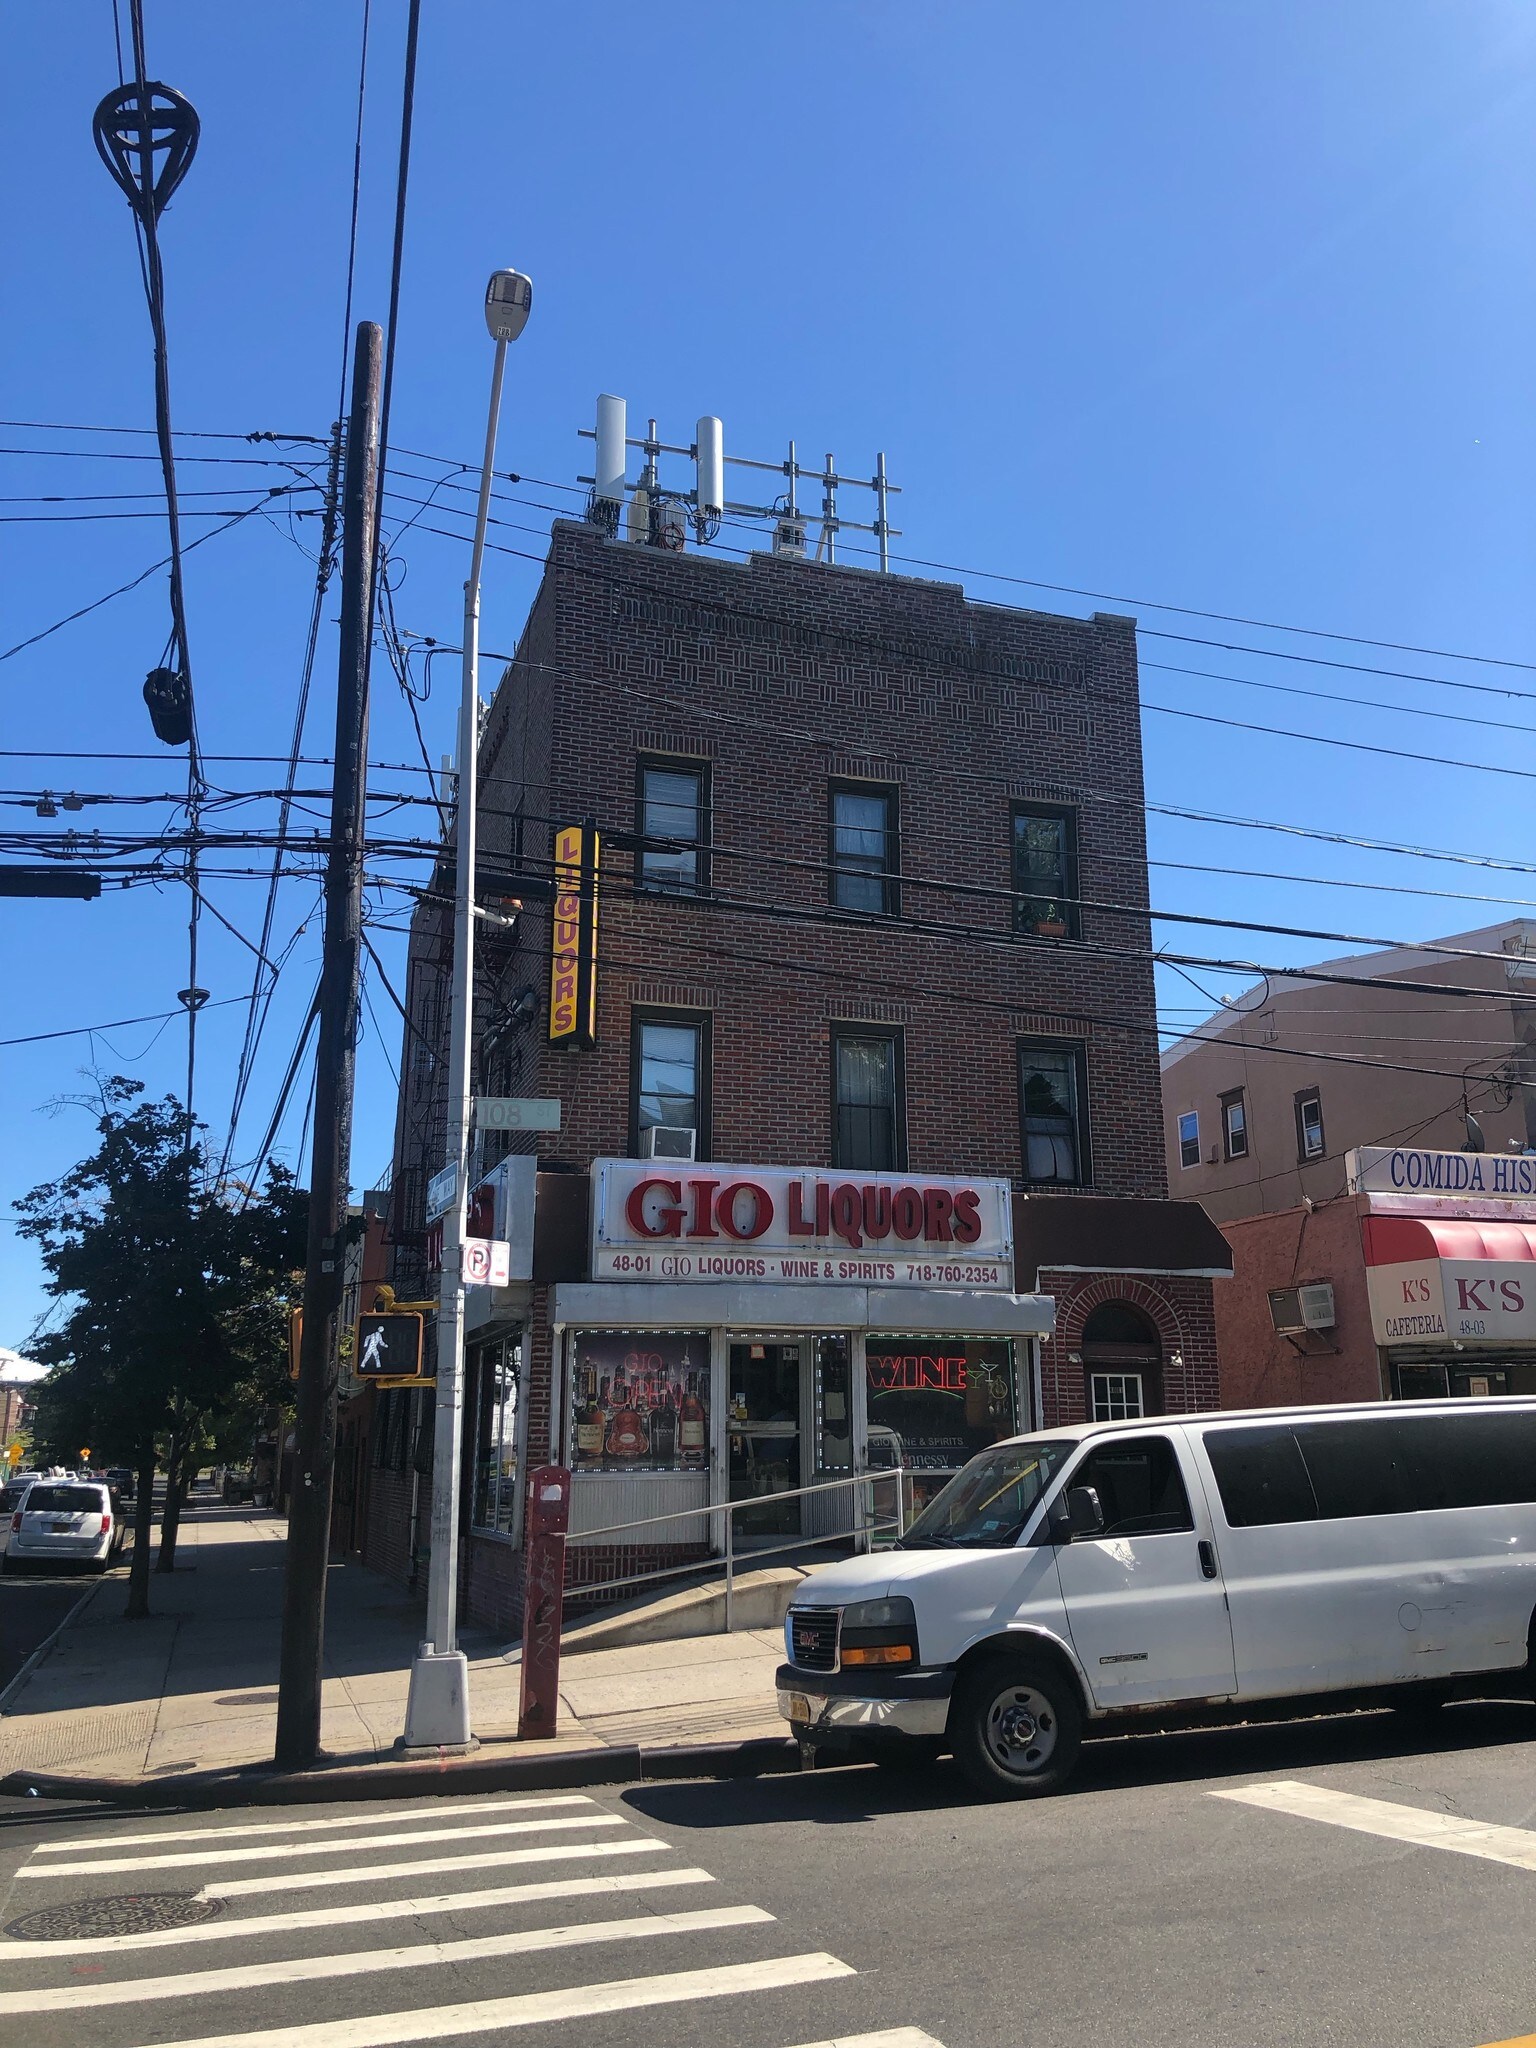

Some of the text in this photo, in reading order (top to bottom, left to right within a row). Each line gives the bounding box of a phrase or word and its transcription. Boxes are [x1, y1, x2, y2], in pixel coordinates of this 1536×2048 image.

[554, 837, 578, 1032] LIQUORS
[483, 1102, 521, 1126] 108
[1391, 1152, 1486, 1192] COMIDA
[625, 1179, 981, 1249] GIO LIQUORS
[612, 1255, 651, 1272] 48-01
[661, 1257, 692, 1276] GIO
[698, 1257, 766, 1276] LIQUORS
[781, 1260, 819, 1278] WINE
[823, 1262, 834, 1279] &
[838, 1262, 895, 1280] SPIRITS
[907, 1265, 998, 1283] 718-760-2354
[1402, 1278, 1431, 1304] K'S
[1455, 1278, 1525, 1313] K'S
[1386, 1314, 1445, 1337] CAFETERIA
[1459, 1320, 1486, 1335] 48-03
[625, 1353, 663, 1372] GIO
[866, 1355, 967, 1389] WINE
[607, 1379, 685, 1409] OPEN
[928, 1437, 964, 1447] SPIRITS
[890, 1451, 950, 1466] Hennessy
